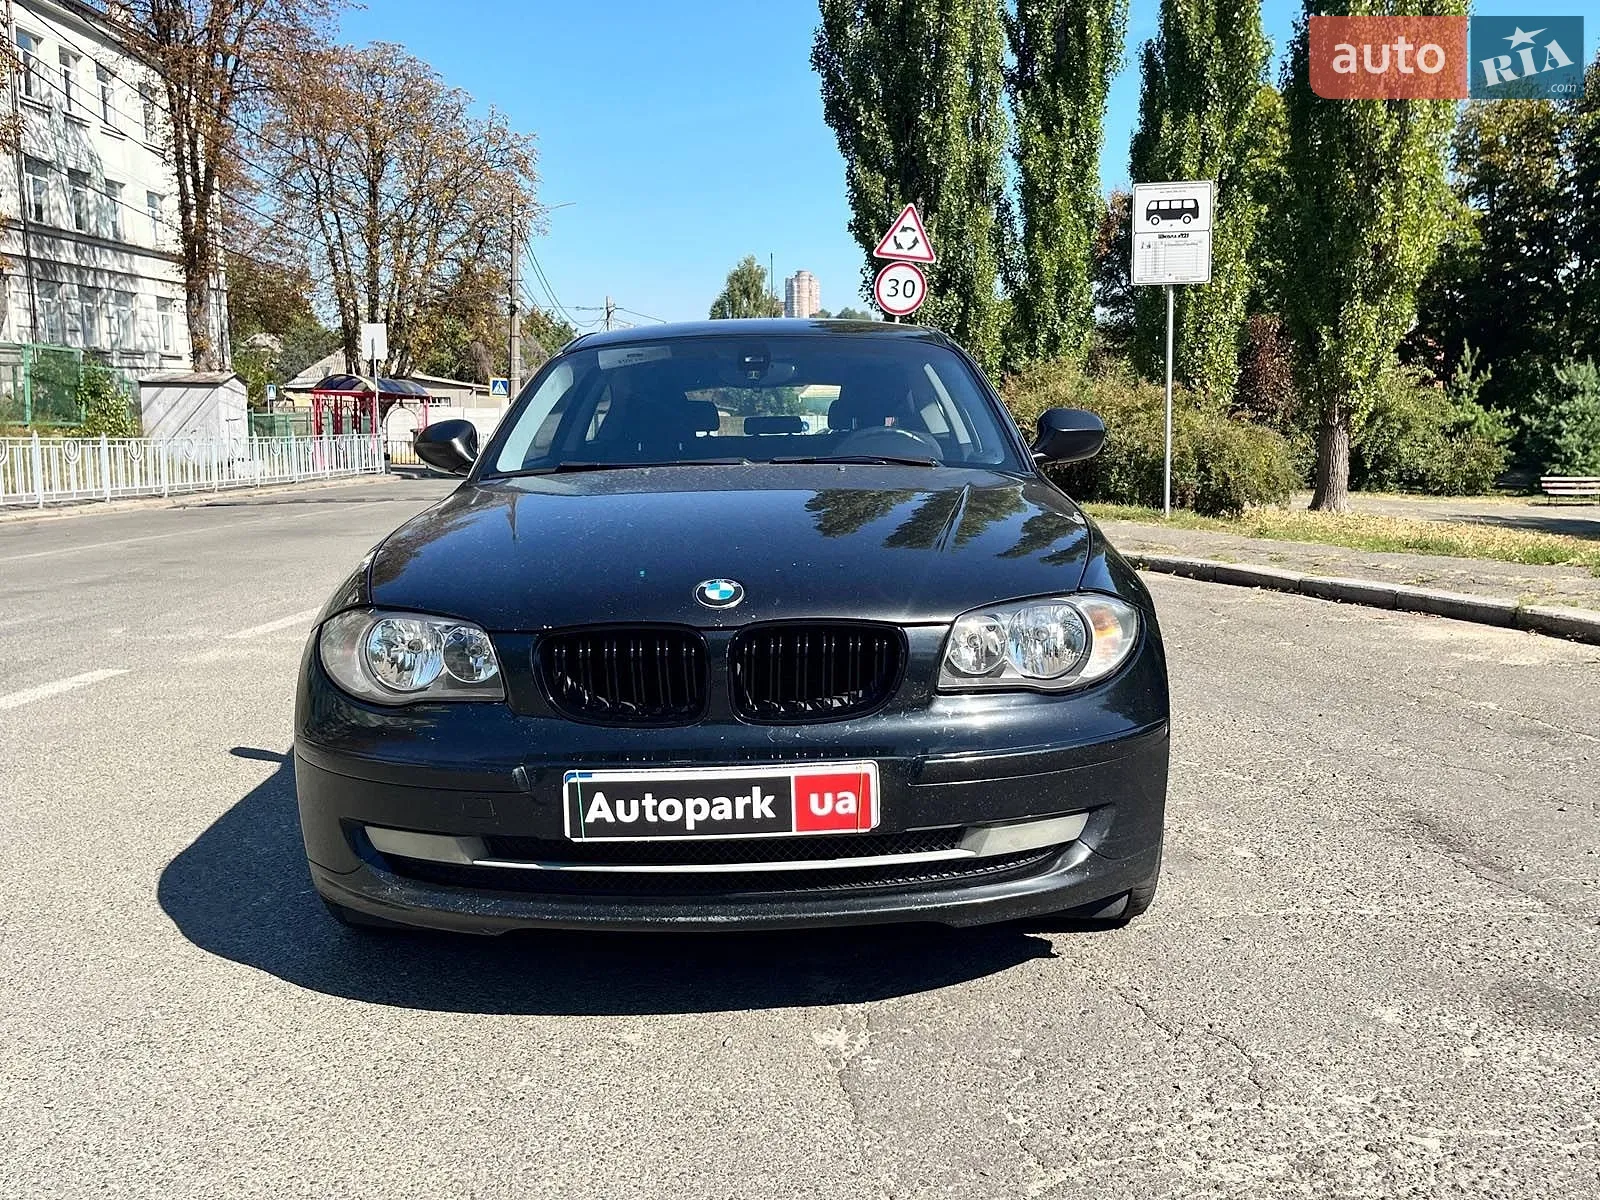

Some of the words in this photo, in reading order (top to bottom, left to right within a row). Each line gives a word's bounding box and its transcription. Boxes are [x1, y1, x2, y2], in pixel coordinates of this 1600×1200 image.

[886, 278, 916, 298] 30
[584, 786, 776, 830] Autopark
[809, 790, 858, 817] ua
